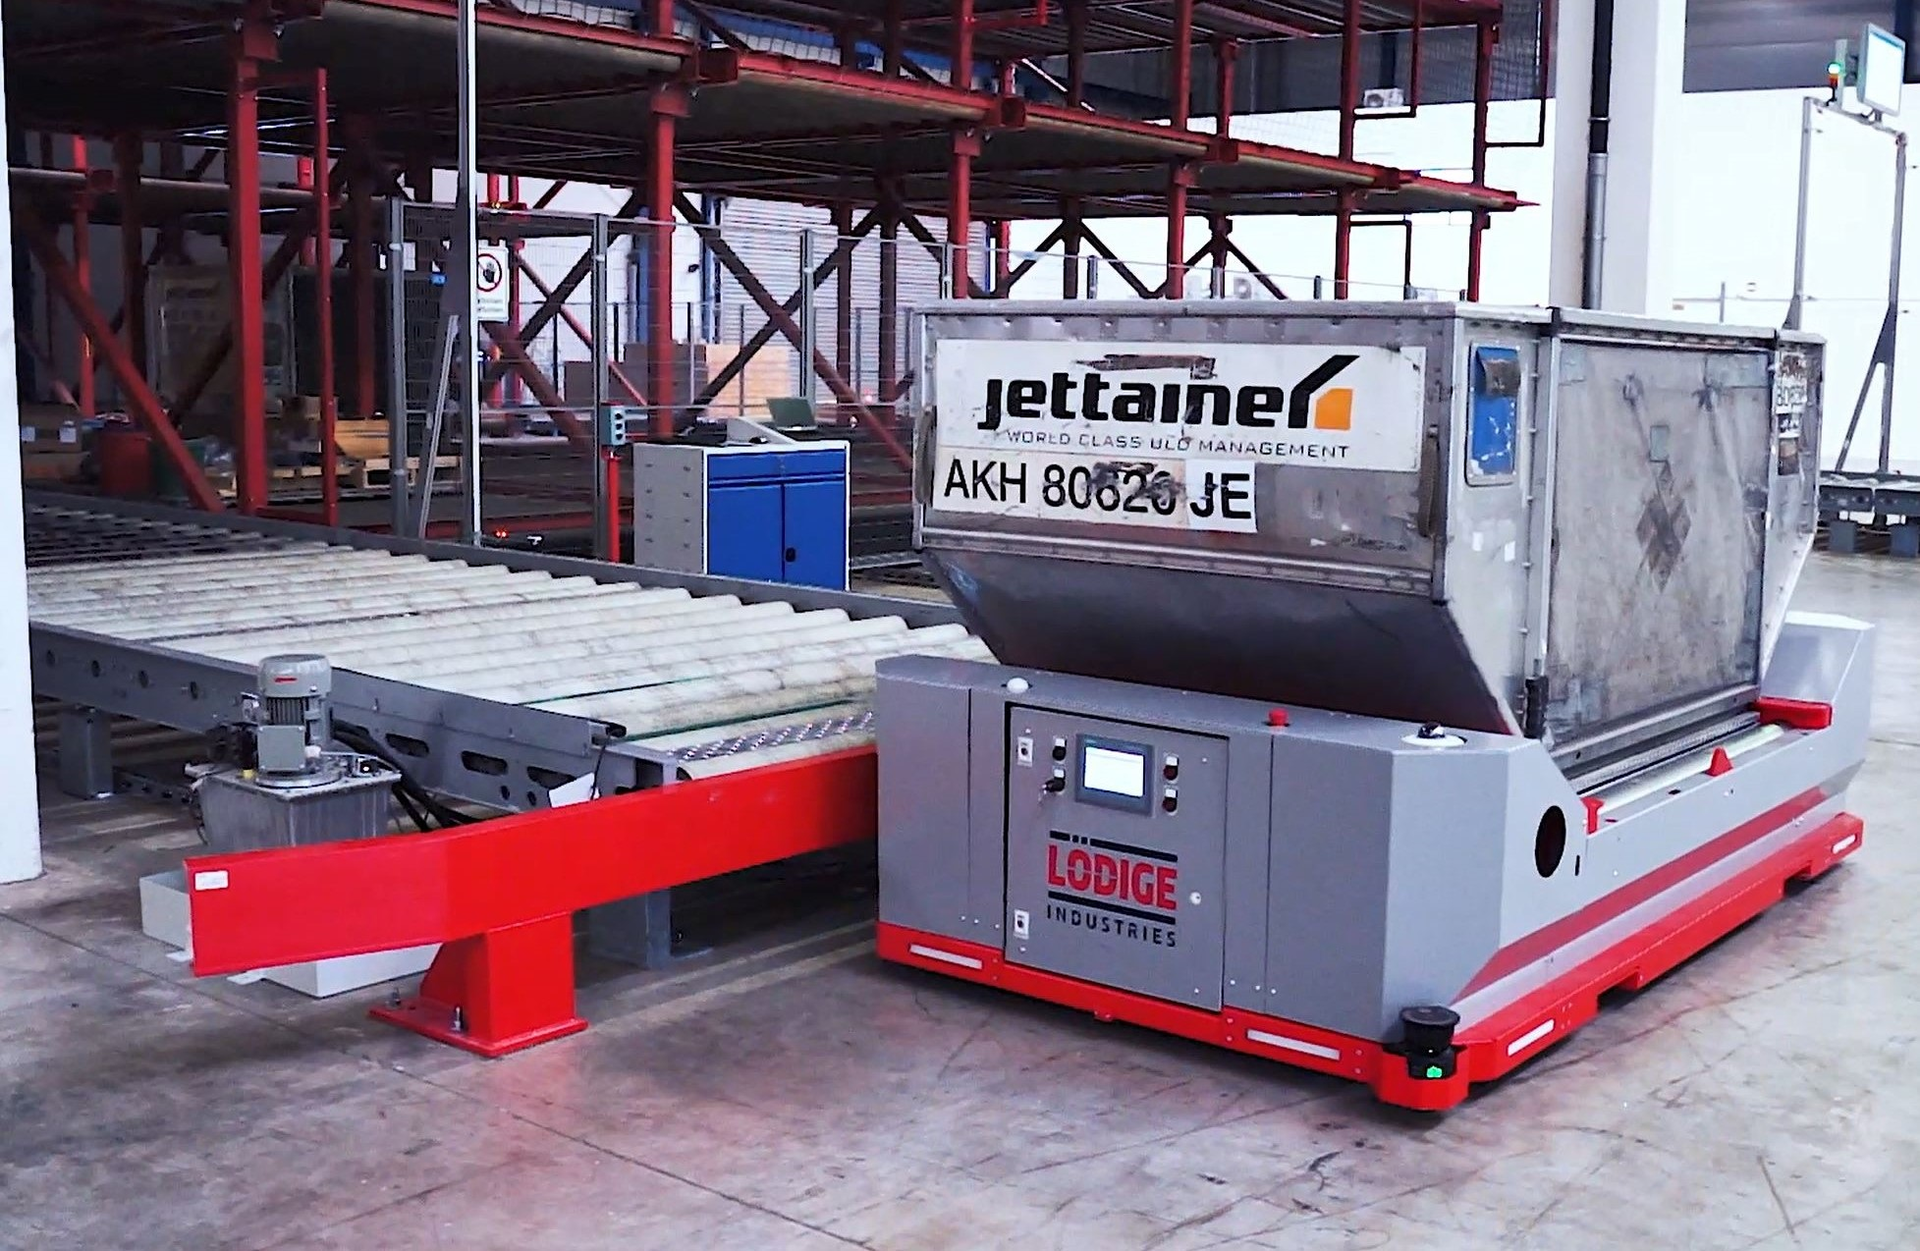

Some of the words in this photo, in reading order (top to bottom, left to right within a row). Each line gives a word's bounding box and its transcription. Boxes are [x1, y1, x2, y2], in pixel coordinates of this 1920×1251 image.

[977, 354, 1361, 431] jettainer
[1008, 430, 1071, 445] WORLD
[1079, 434, 1142, 449] CLASS
[1150, 437, 1190, 452] ULD
[1198, 439, 1350, 459] MANAGEMENT
[944, 458, 1027, 504] AKH
[1189, 471, 1252, 520] JE
[1048, 834, 1178, 911] LÖDIGE
[1047, 904, 1177, 948] INDUSTRIES
